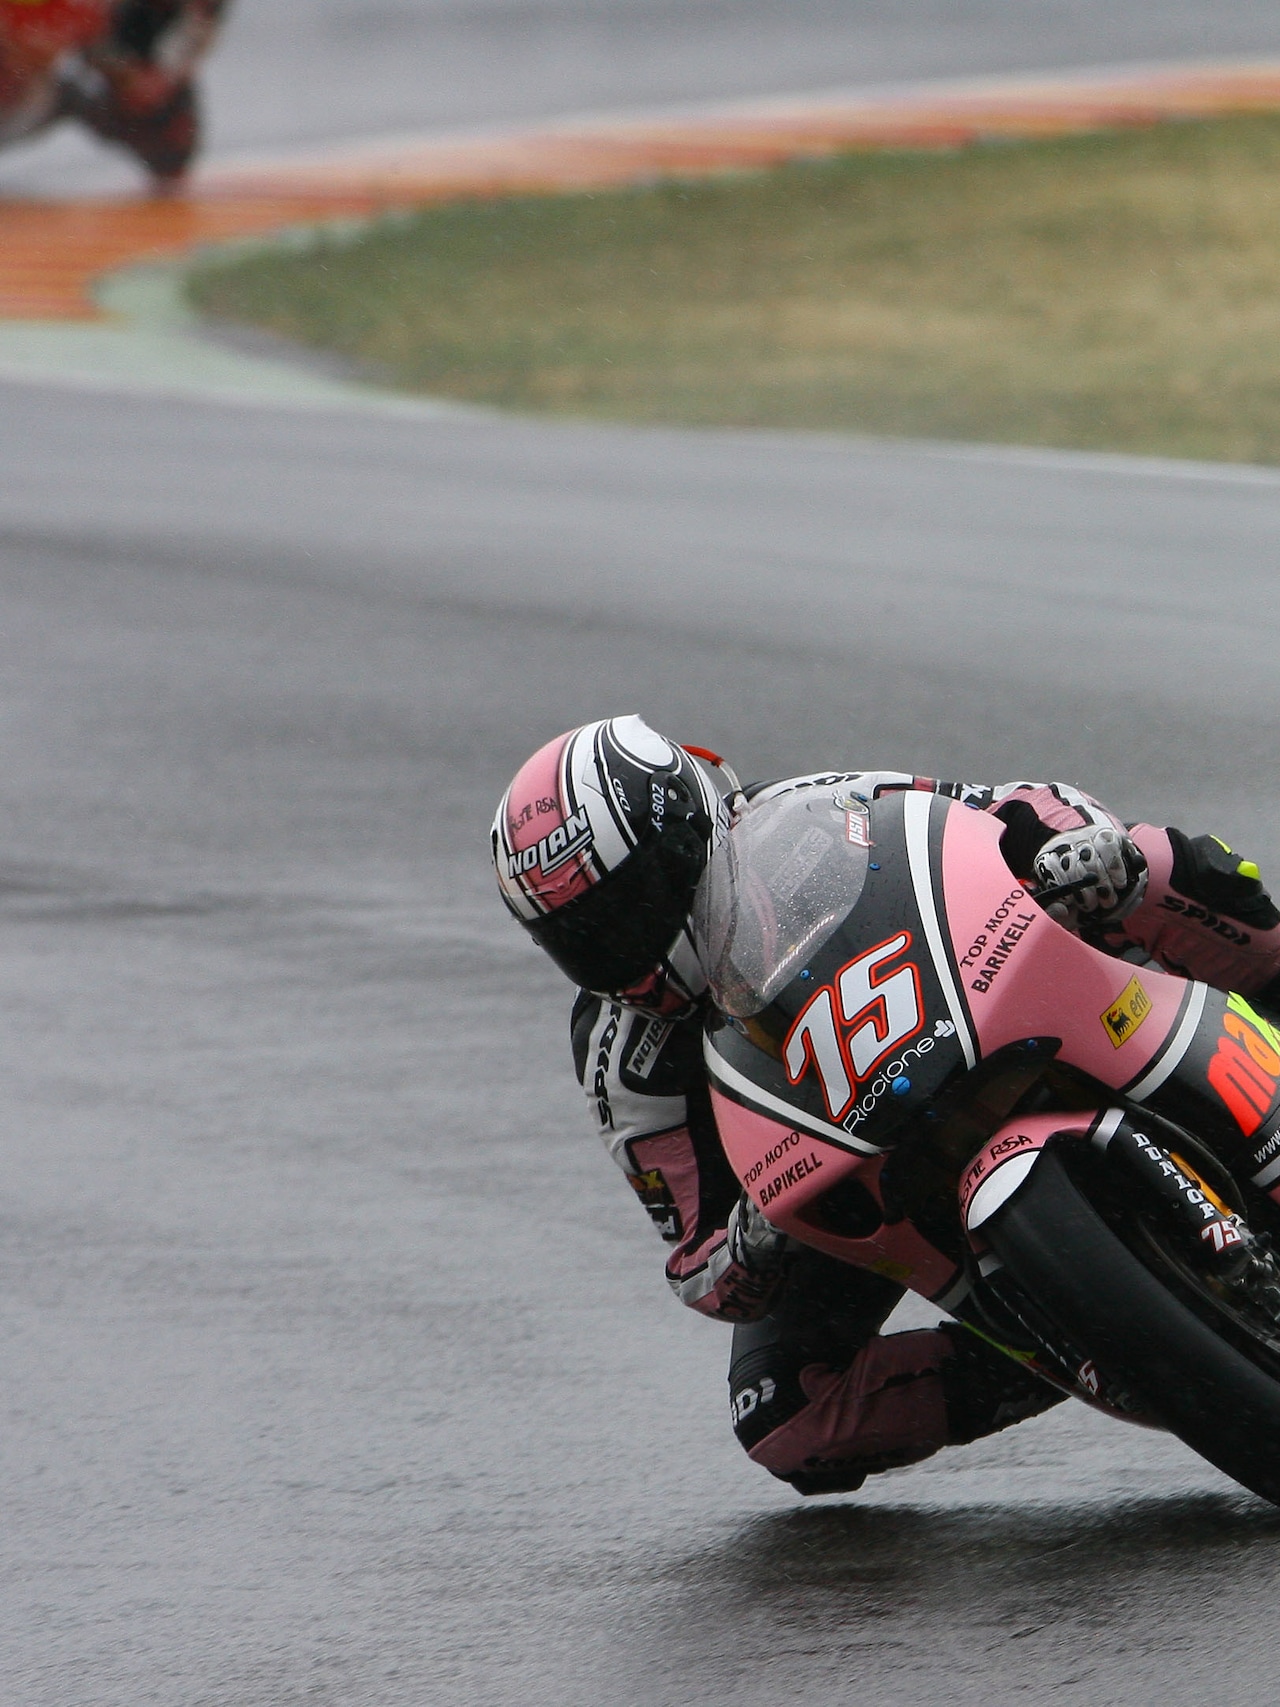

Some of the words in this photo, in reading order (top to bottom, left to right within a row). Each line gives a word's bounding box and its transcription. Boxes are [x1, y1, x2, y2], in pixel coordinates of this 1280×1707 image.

[509, 805, 594, 878] NOLAN
[651, 783, 666, 832] X-802
[960, 933, 987, 970] TOP
[989, 888, 1025, 934] MOTO
[971, 911, 1036, 994] BARIKELL
[782, 930, 925, 1122] 75
[1129, 987, 1148, 1019] eni
[634, 1017, 670, 1073] NOLA
[843, 1036, 936, 1135] Riccione
[743, 1161, 763, 1189] TOP
[765, 1131, 800, 1170] MOTO
[1132, 1132, 1218, 1220] DUNLOP
[1201, 1220, 1242, 1252] 75
